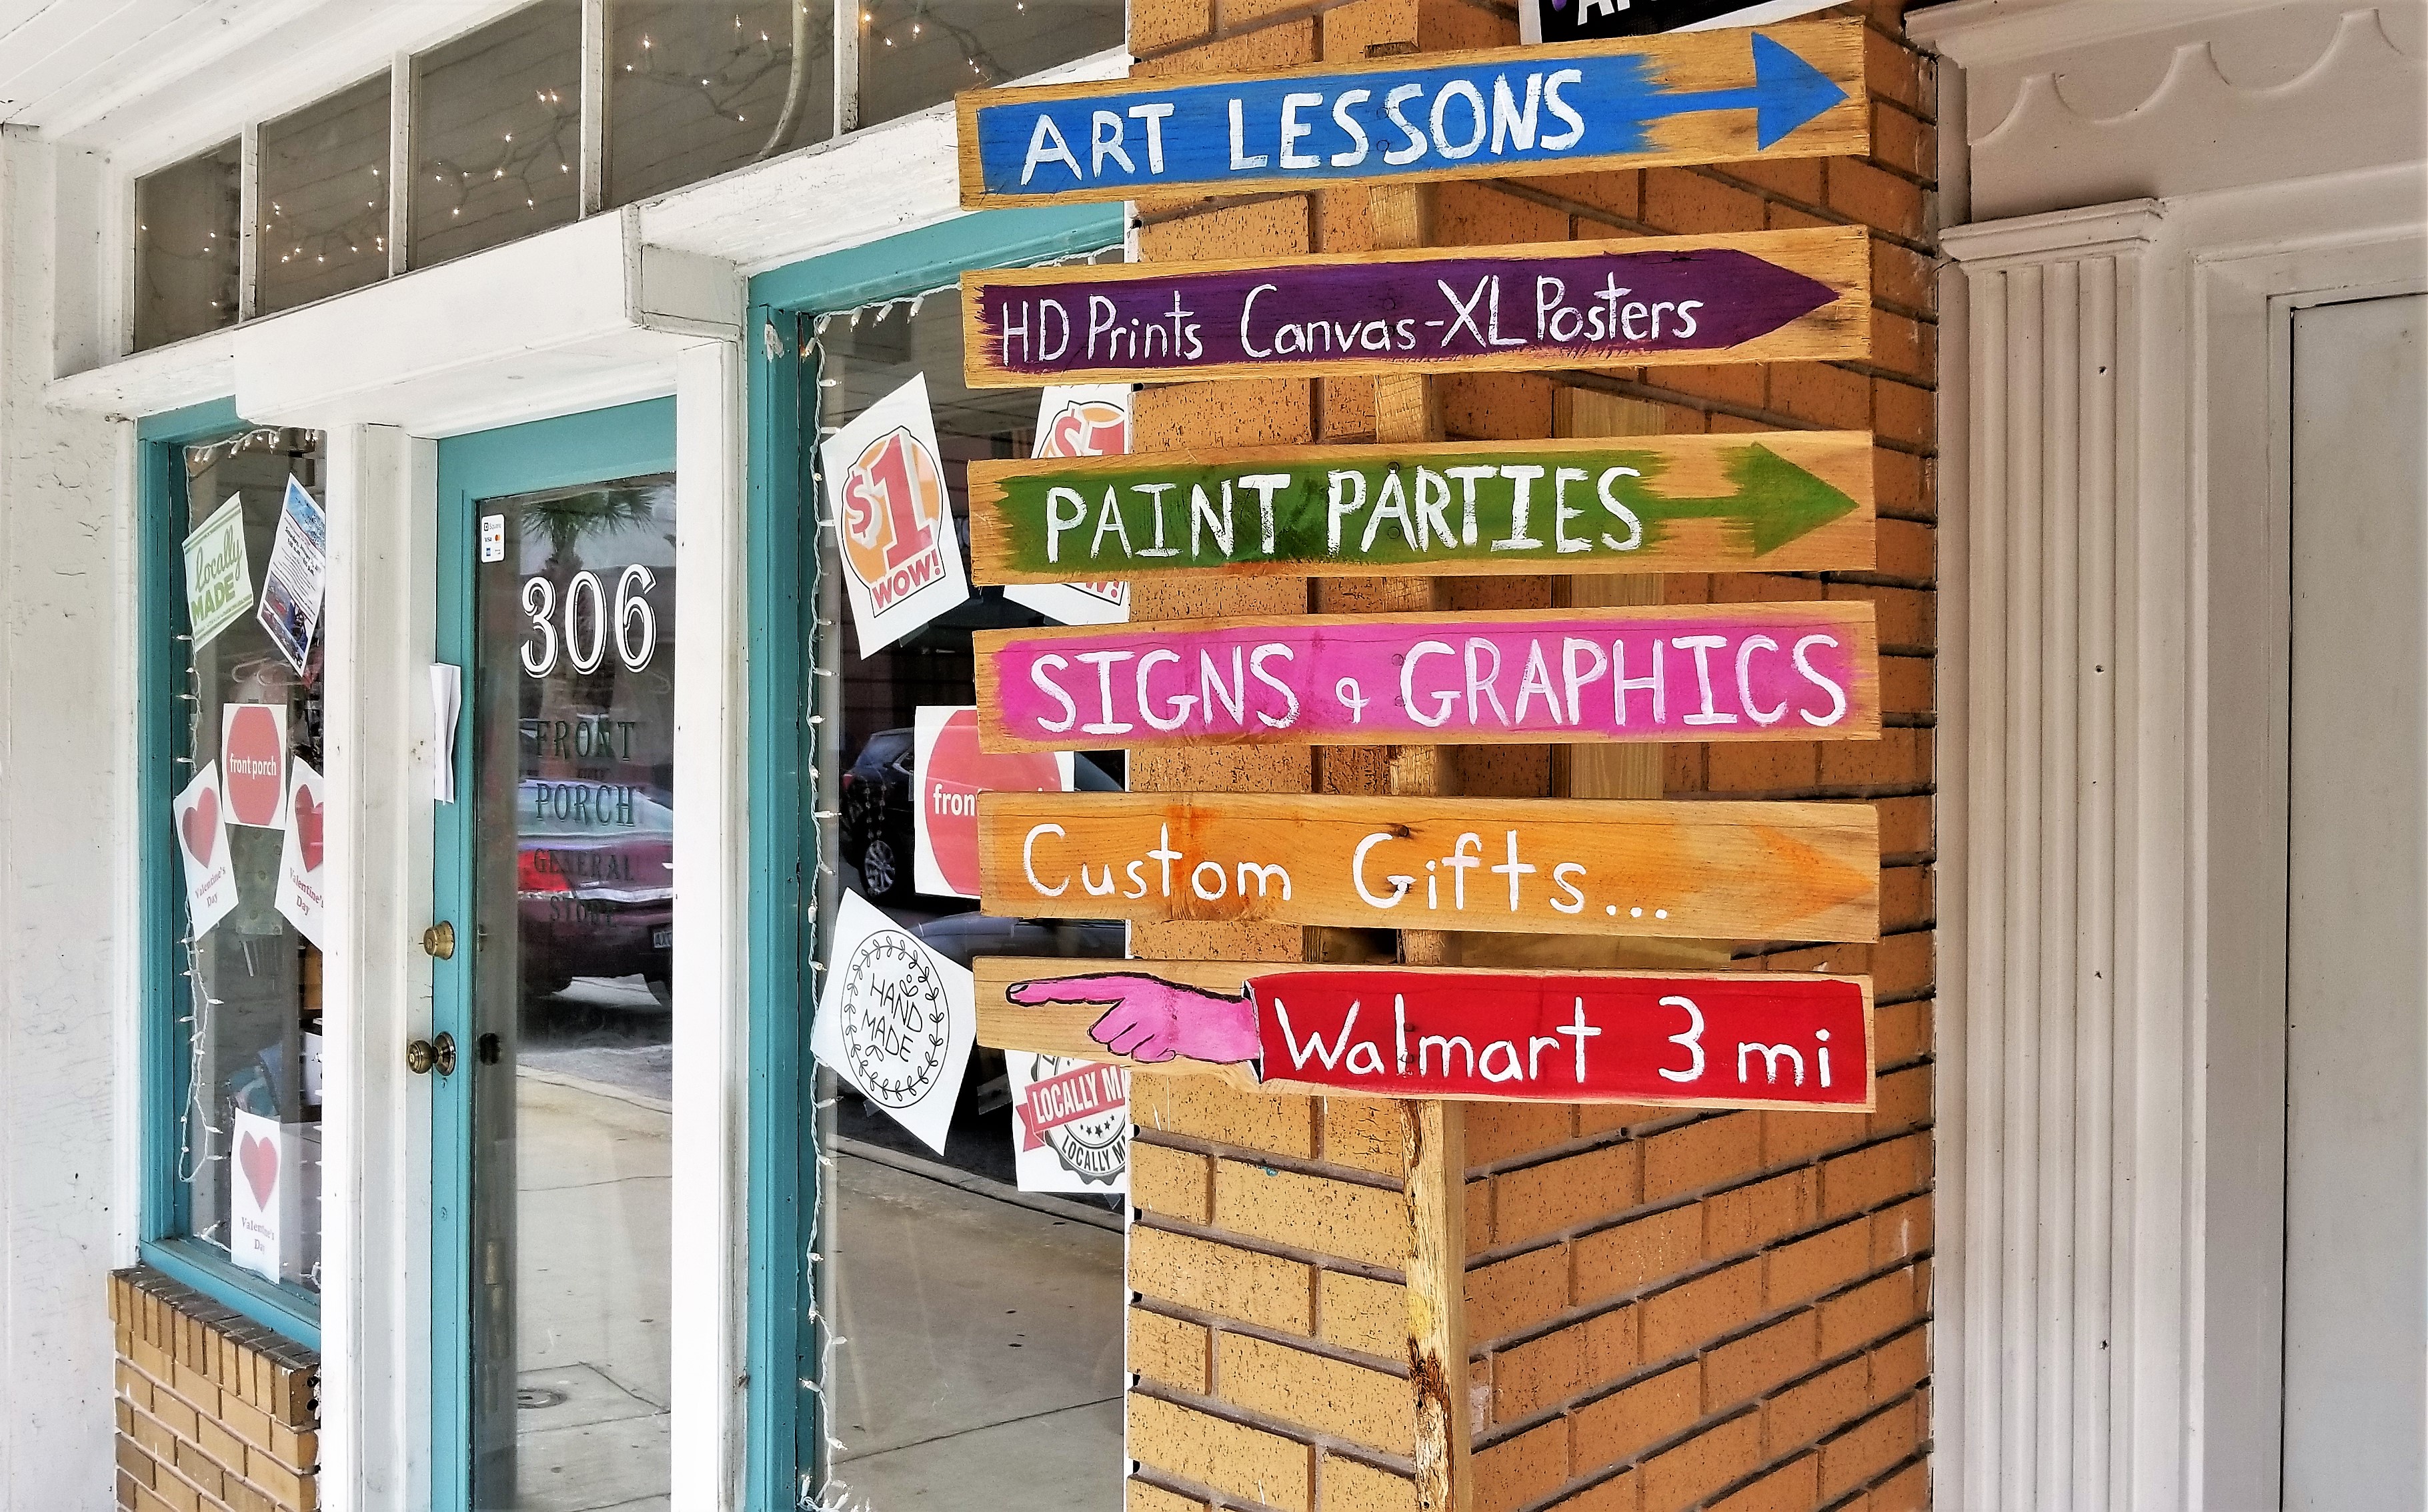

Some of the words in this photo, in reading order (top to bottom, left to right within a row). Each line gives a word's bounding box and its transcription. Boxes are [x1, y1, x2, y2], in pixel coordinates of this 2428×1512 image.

[1020, 103, 1175, 186] ART
[1228, 69, 1585, 171] LESSONS
[1002, 298, 1070, 367] HD
[1087, 289, 1204, 361] Prints
[1536, 271, 1705, 343] Posters
[846, 433, 934, 571] $1
[1046, 472, 1291, 564] PAINT
[1326, 464, 1642, 556] PARTIES
[195, 524, 243, 593] locally
[872, 551, 941, 609] WOW!
[191, 571, 236, 626] MADE
[519, 563, 657, 679] 306
[1030, 642, 1300, 735] SIGNS
[1399, 634, 1847, 727] GRAPHICS
[229, 753, 251, 773] front
[253, 755, 277, 780] porch
[535, 719, 636, 761] FRONT
[535, 782, 636, 827] PORCH
[194, 866, 226, 899] Valentine's
[206, 891, 218, 908] Day
[1022, 821, 1291, 901] Custom
[1351, 829, 1668, 920] Gifts...
[296, 895, 311, 916] Day
[870, 973, 923, 1033] HAND
[861, 1008, 914, 1063] MADE
[1274, 993, 1603, 1084] Walmart
[1658, 995, 1706, 1083] 3
[1738, 1028, 1832, 1088] mi
[1032, 1071, 1100, 1125] LOCALLY
[1062, 1133, 1112, 1172] LOCALLY
